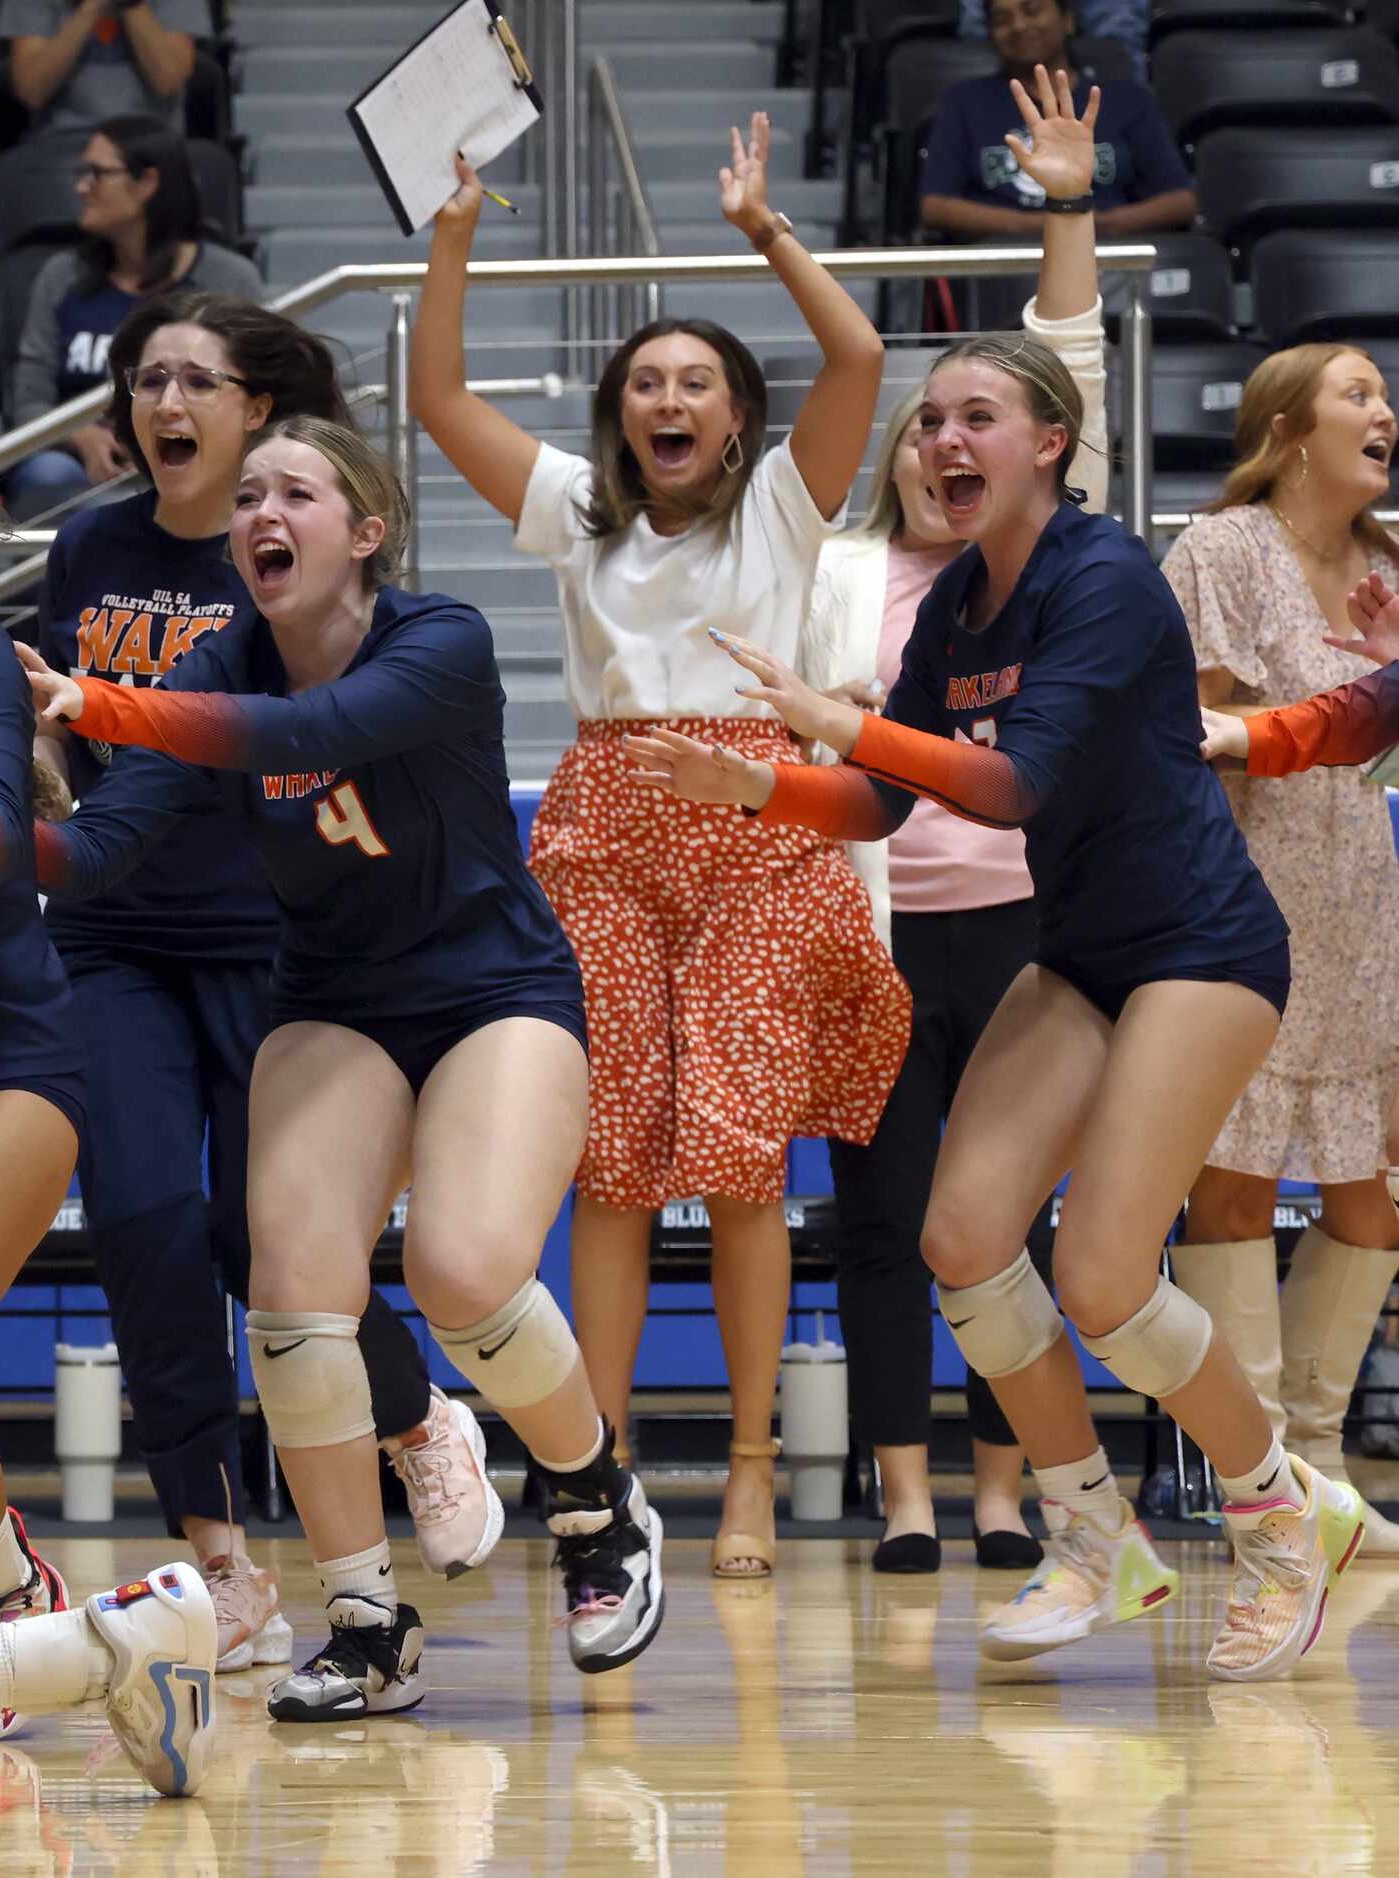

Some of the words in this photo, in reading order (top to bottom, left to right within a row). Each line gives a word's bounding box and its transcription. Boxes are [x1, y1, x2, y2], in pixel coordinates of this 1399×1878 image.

[102, 594, 175, 616] VOLLEYBALL
[177, 603, 234, 617] PLAYOFFS
[152, 589, 172, 602] UIL
[313, 778, 392, 861] 4
